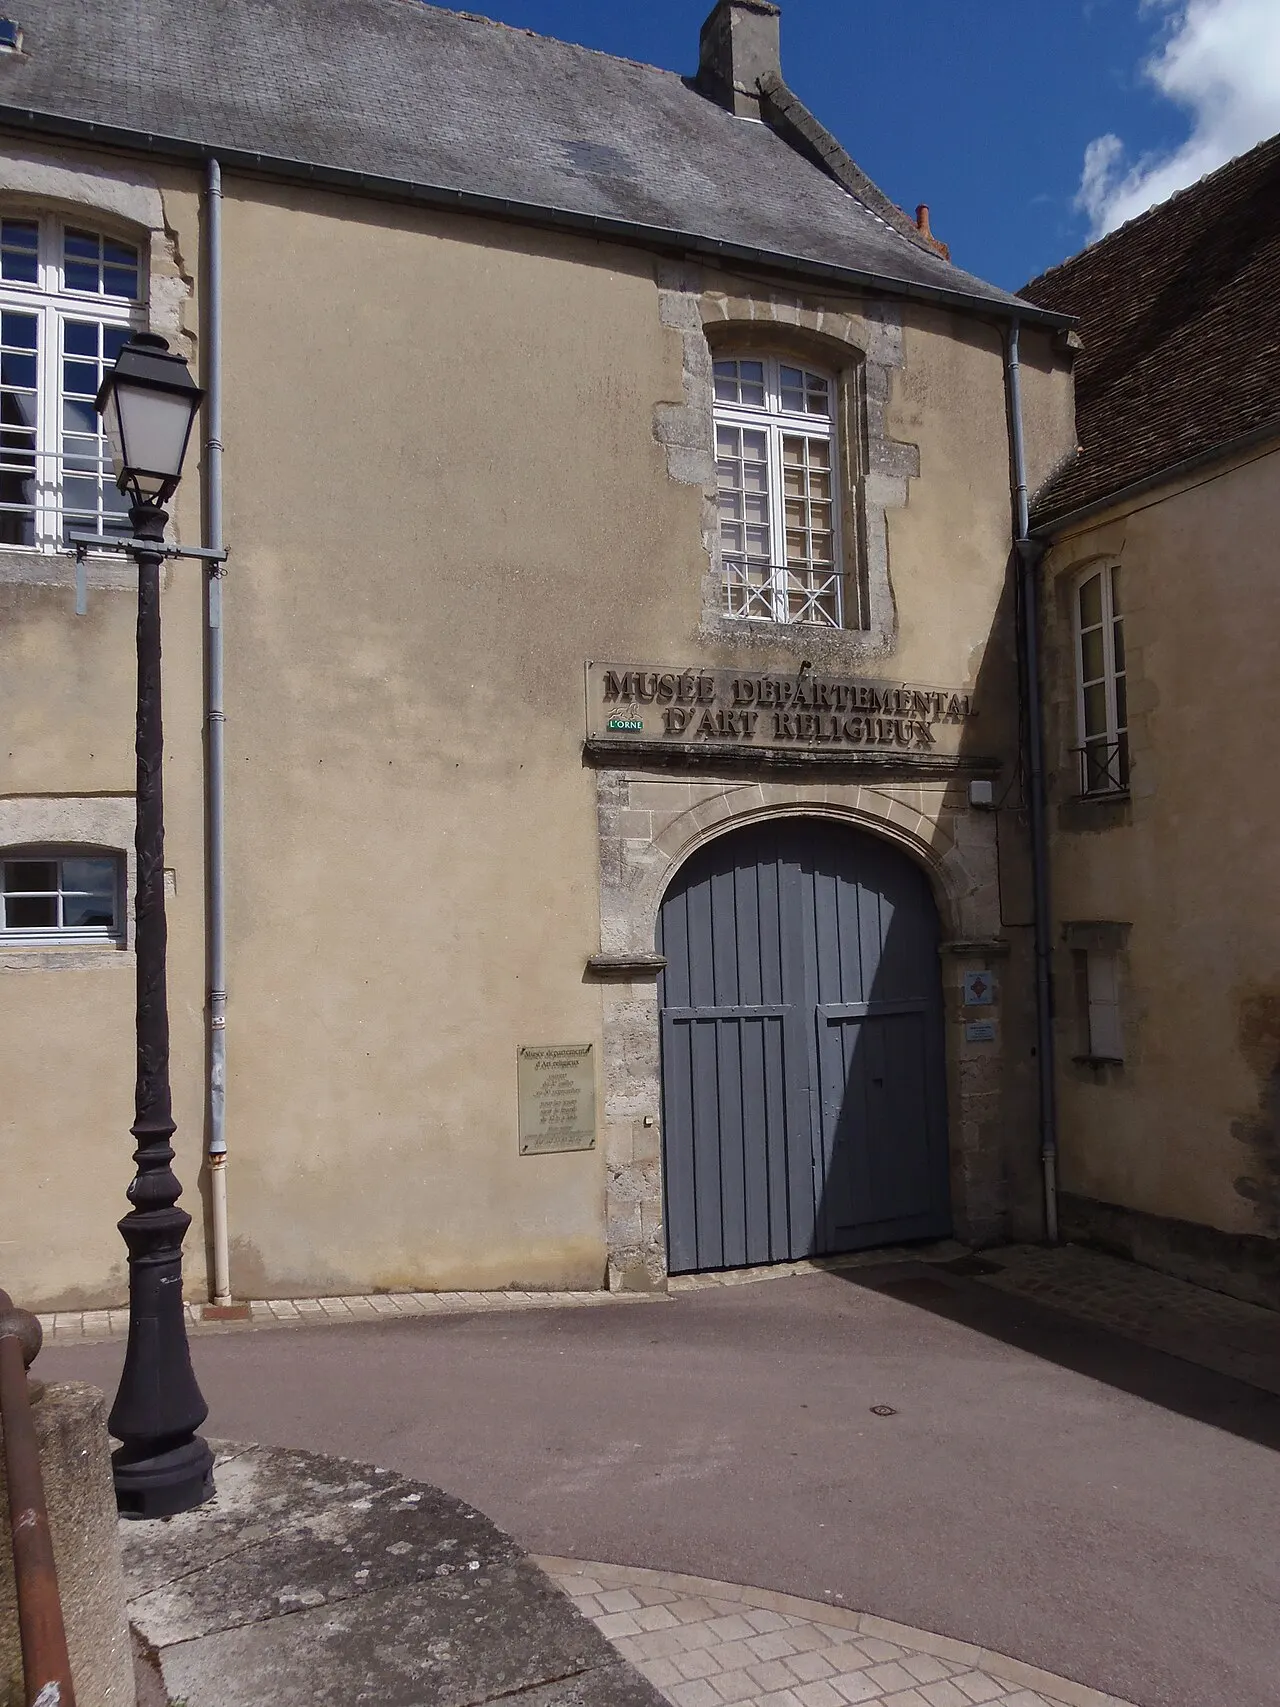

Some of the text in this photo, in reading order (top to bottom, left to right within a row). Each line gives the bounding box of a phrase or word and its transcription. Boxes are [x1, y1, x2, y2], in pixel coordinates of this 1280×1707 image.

[606, 668, 977, 717] MUSÉE DÉPARTEMENTAL
[610, 720, 642, 729] L'ORNE
[664, 707, 937, 744] D'ART RELIGIEUX
